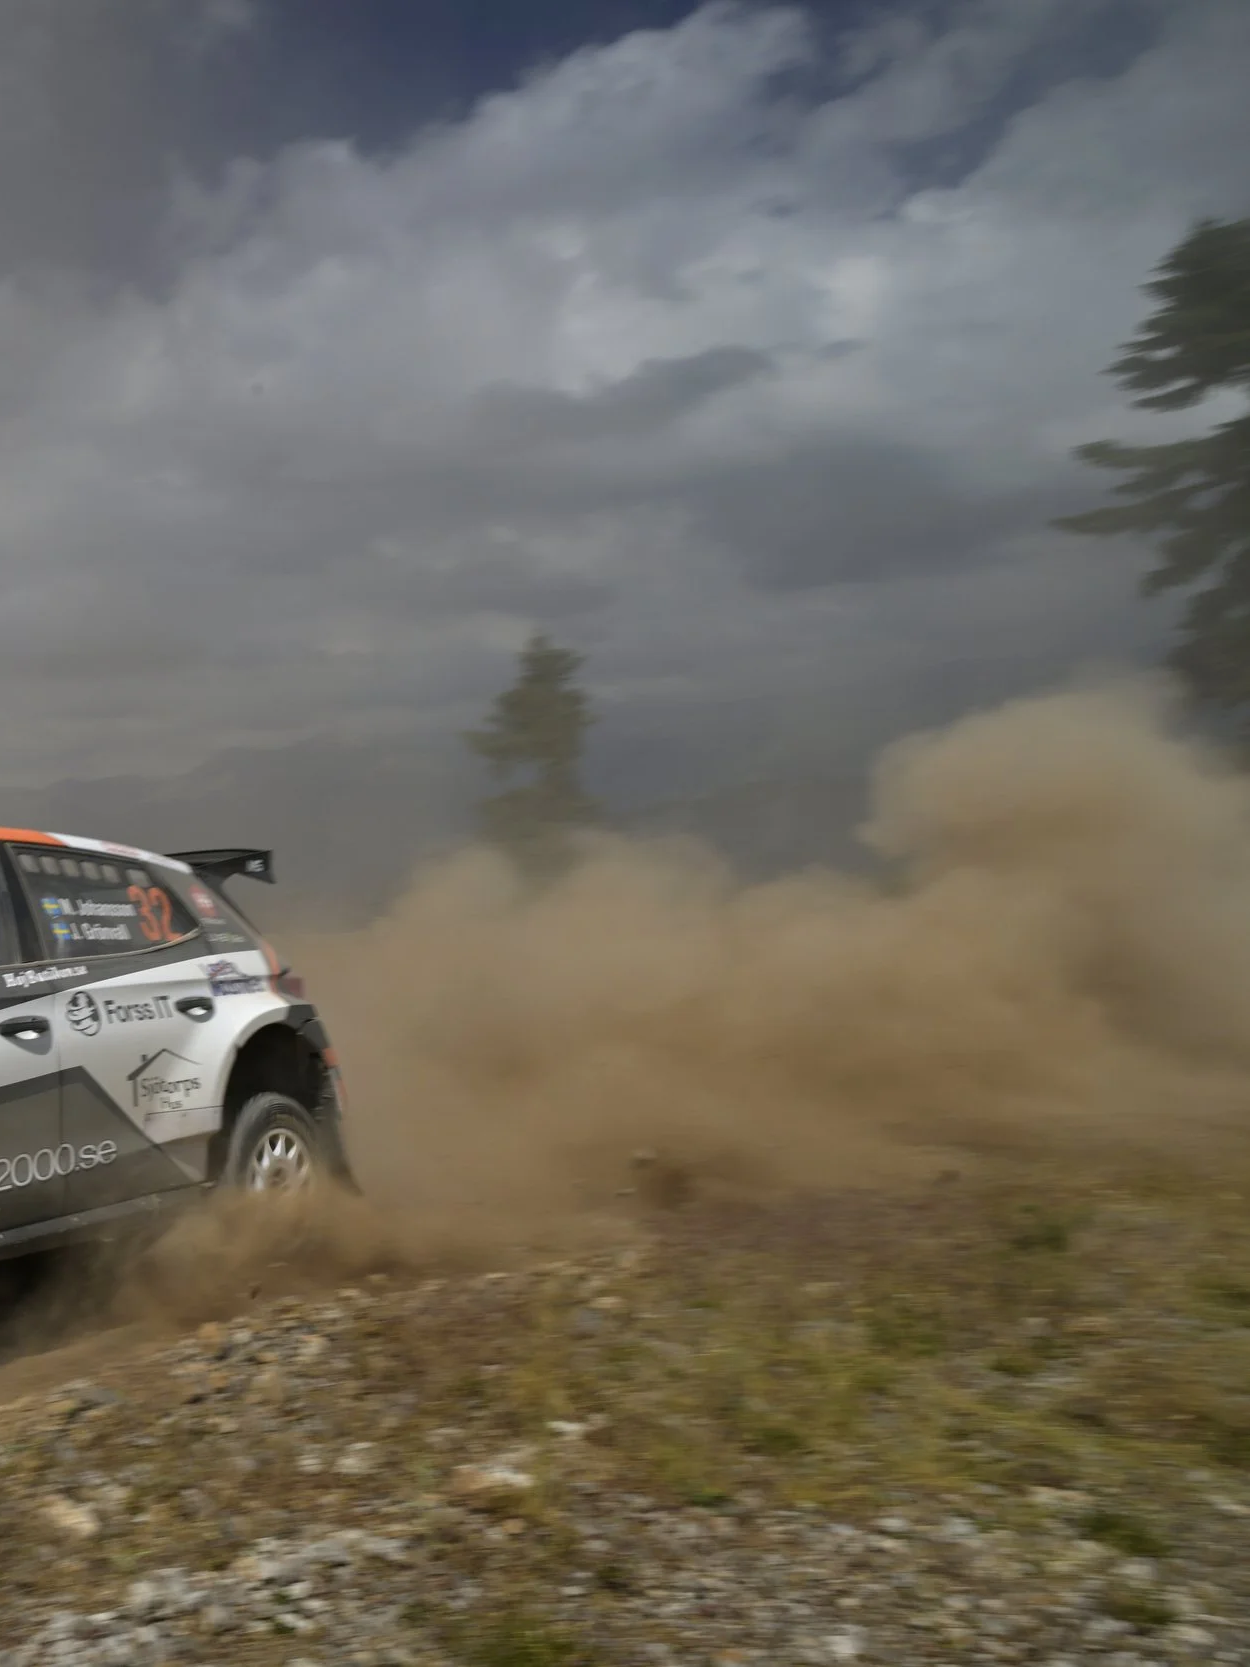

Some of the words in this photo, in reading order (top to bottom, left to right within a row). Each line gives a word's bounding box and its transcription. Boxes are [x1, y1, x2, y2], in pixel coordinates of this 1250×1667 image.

[127, 885, 183, 941] 32
[103, 1000, 153, 1024] Forss
[152, 995, 174, 1018] IT
